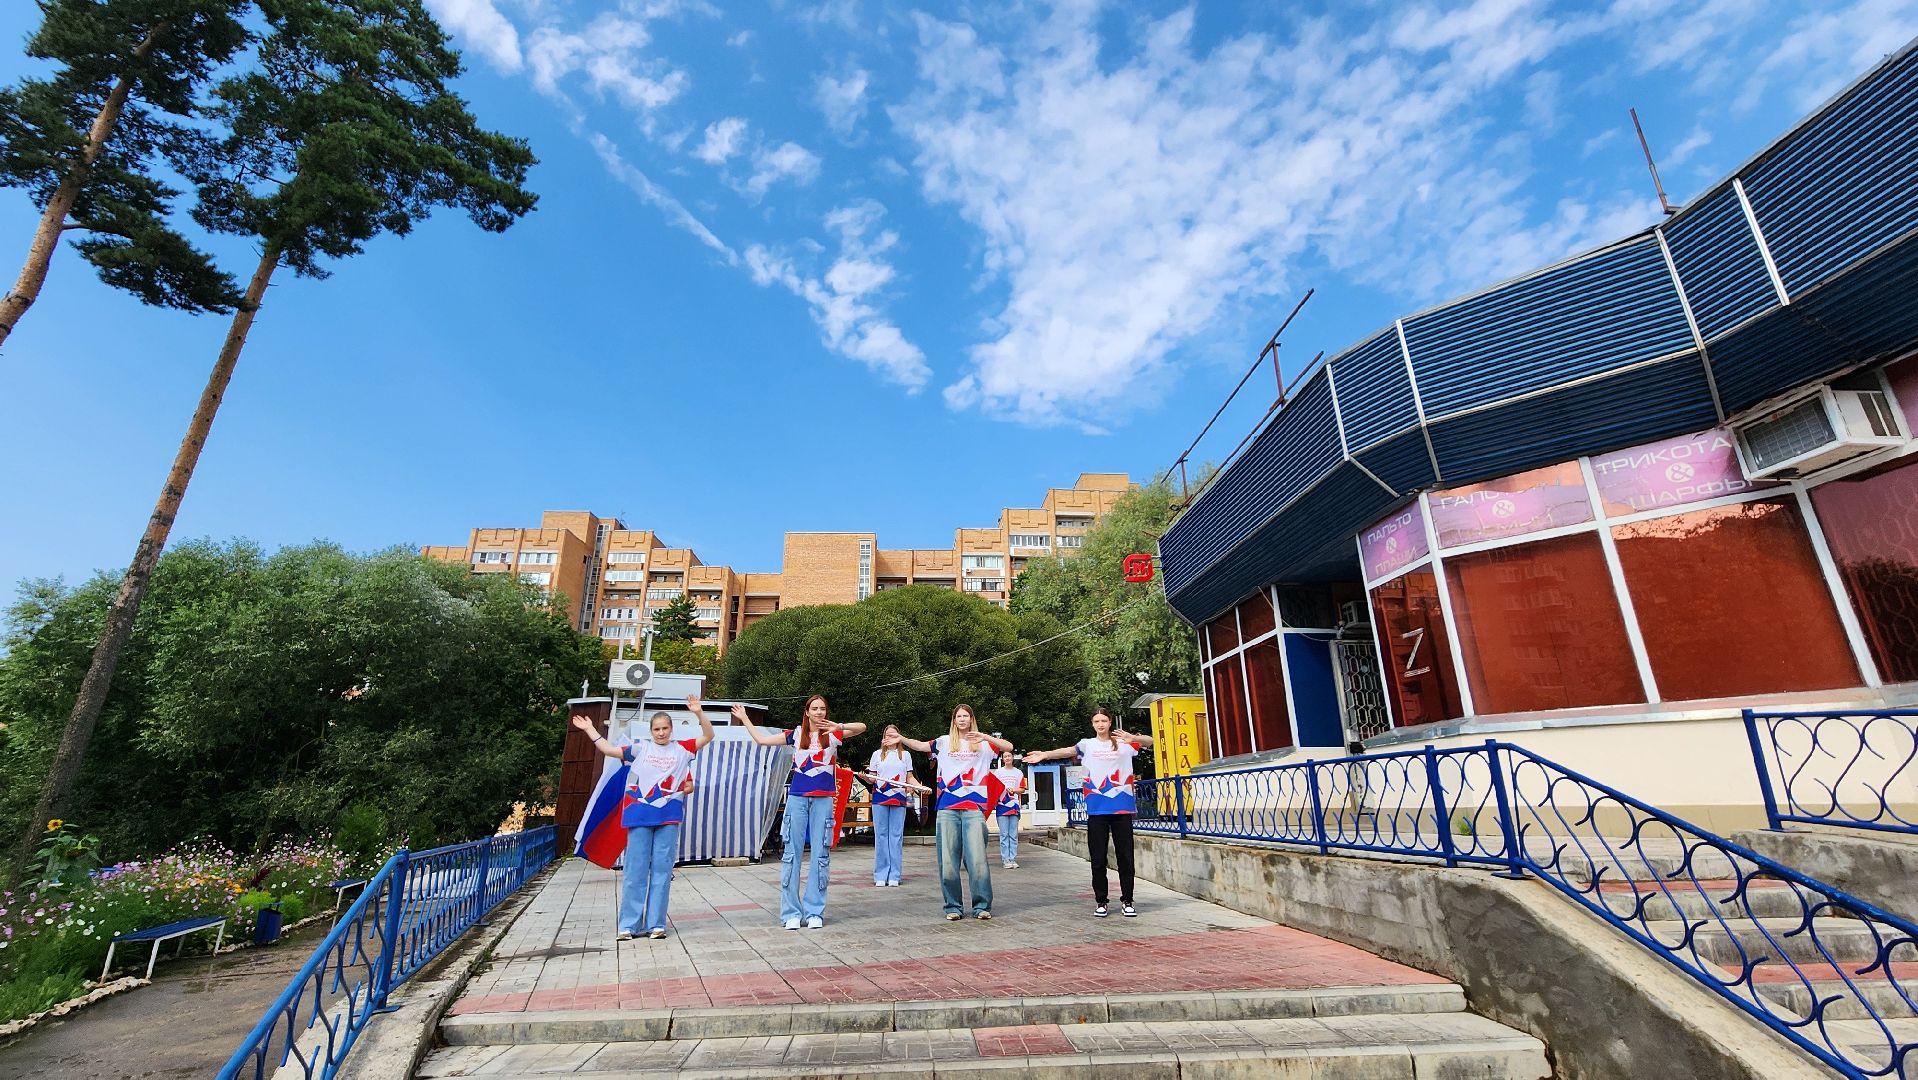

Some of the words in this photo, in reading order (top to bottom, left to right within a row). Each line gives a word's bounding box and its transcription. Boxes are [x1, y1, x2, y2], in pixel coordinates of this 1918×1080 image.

[1596, 437, 1732, 475] ТРИКОТА
[1628, 479, 1753, 509] ШАРФЫ
[1367, 512, 1412, 545] ПАЛЬТО
[1402, 627, 1430, 678] Z
